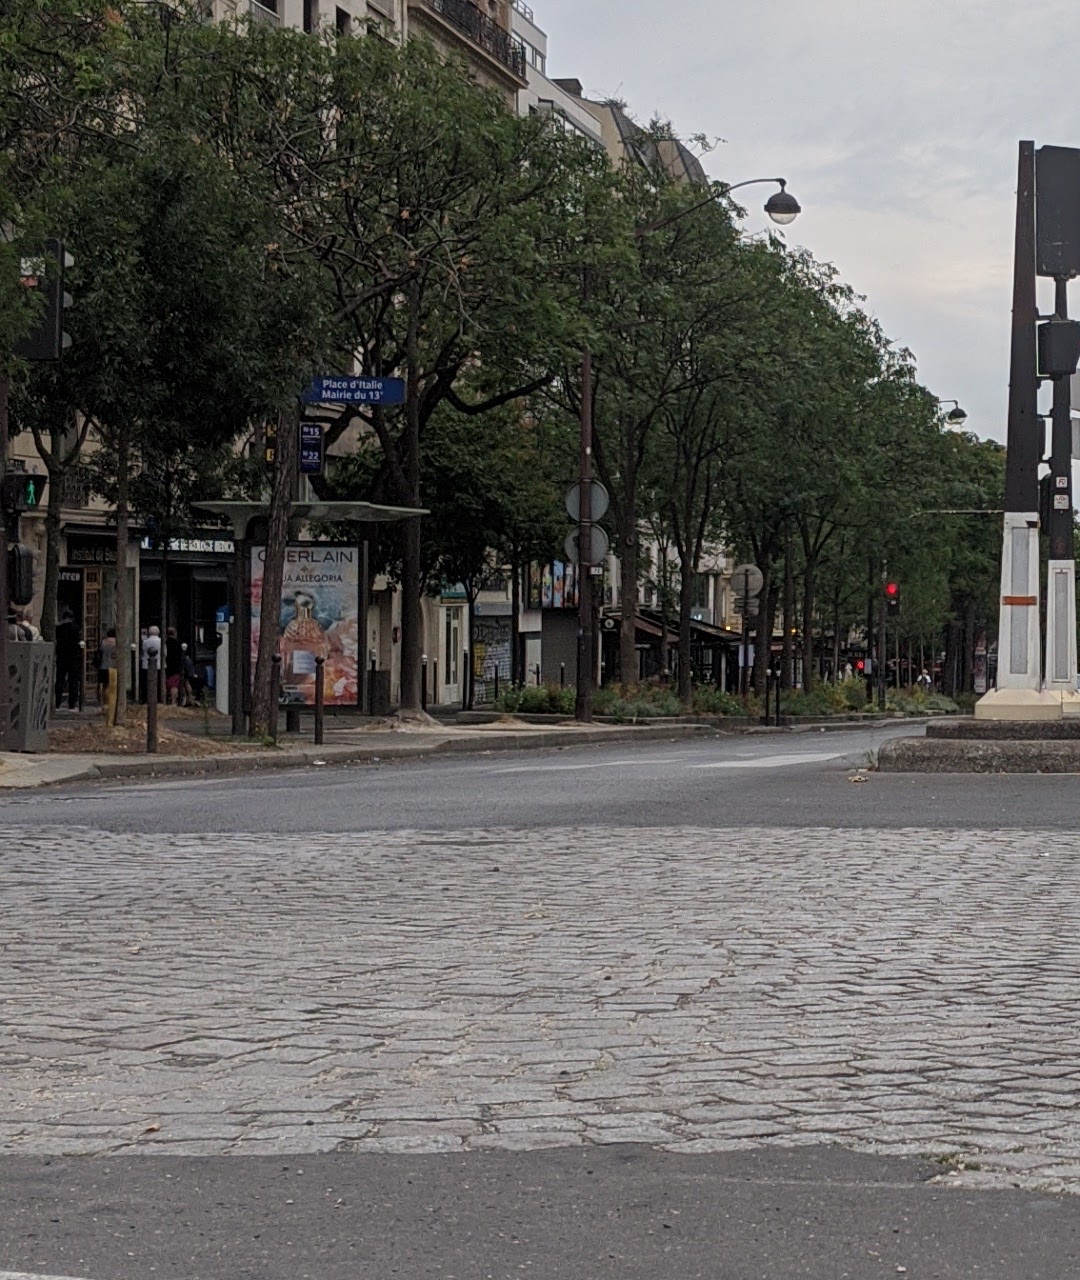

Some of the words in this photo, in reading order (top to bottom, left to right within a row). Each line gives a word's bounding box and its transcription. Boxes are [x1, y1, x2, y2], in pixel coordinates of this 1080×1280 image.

[322, 380, 348, 389] Place
[350, 380, 383, 390] d'Italie
[321, 390, 352, 399] Mairie
[354, 391, 367, 400] du
[257, 550, 353, 563] GERLAIN
[295, 574, 343, 583] ALLEGORIA
